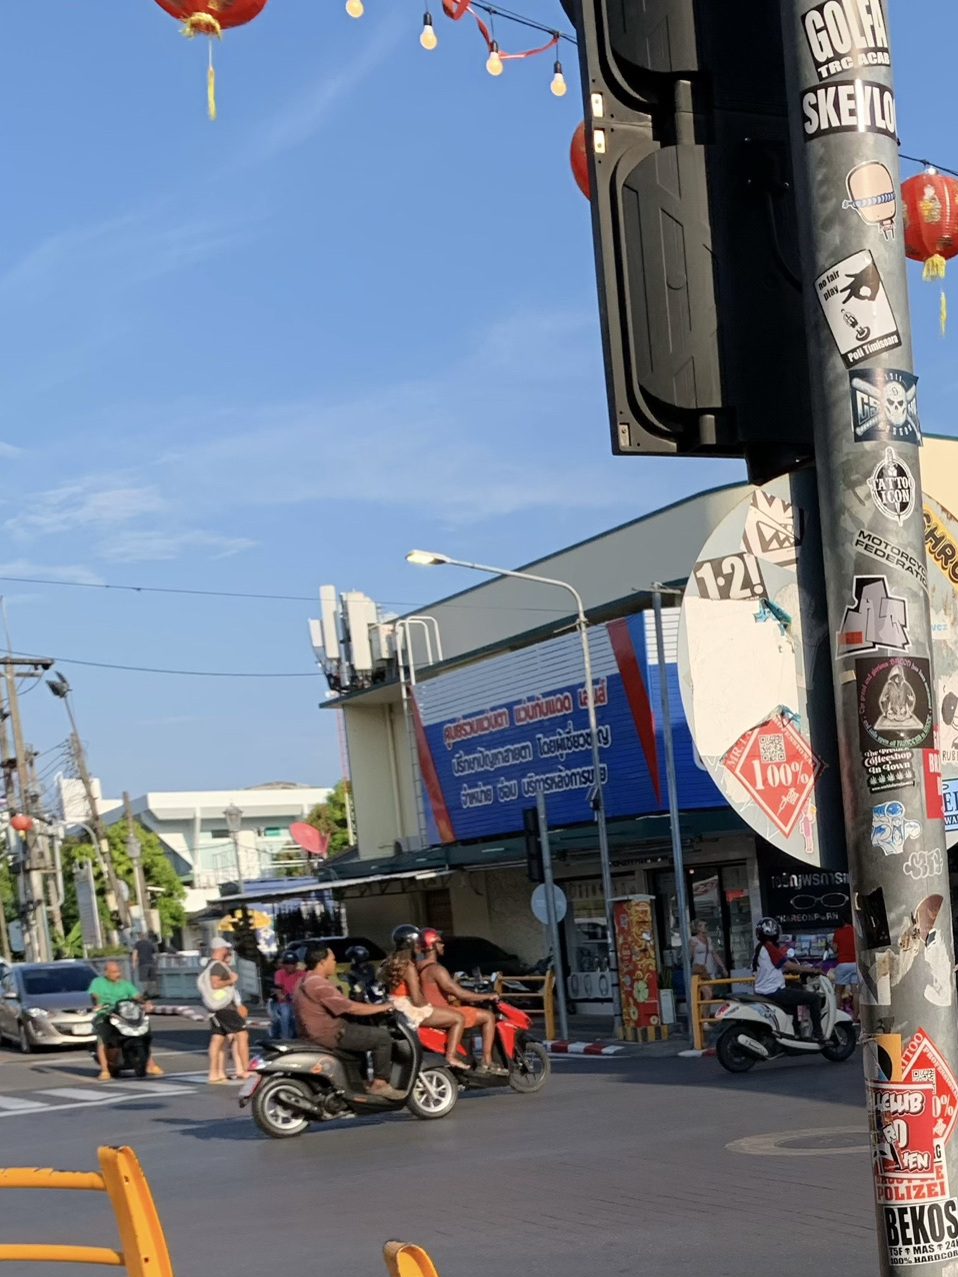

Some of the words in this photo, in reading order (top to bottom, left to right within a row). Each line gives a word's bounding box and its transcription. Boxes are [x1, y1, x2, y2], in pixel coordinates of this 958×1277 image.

[817, 56, 854, 78] TRC
[823, 284, 839, 302] play
[848, 347, 862, 363] Poli
[880, 489, 910, 504] ICON
[536, 722, 611, 761] โดยผู้เชี่ยวชญ
[522, 764, 607, 797] บริการหลังการขย
[752, 760, 809, 790] 100%
[900, 1032, 924, 1070] TTOO
[876, 1181, 946, 1201] POLIZEI
[913, 1244, 935, 1255] MAS
